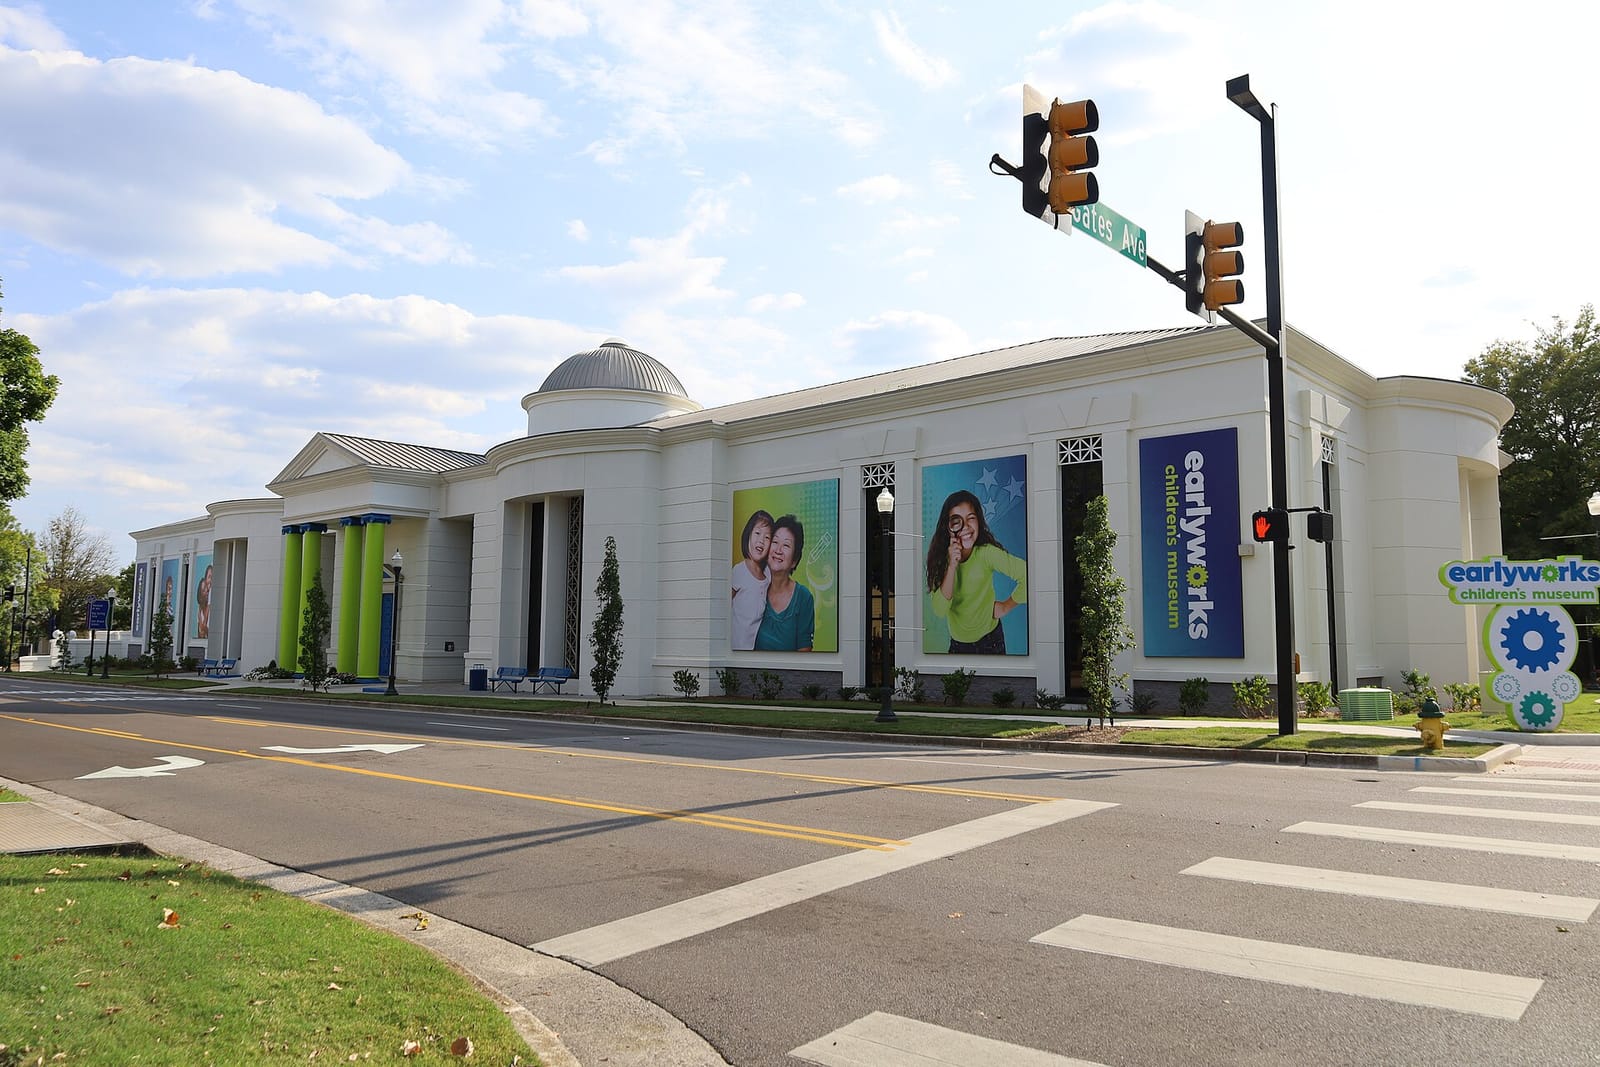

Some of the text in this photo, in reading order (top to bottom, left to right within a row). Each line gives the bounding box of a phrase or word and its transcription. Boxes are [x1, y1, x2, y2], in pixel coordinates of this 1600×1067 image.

[1073, 205, 1145, 260] Gates Ave
[1165, 464, 1181, 629] children's museum
[1179, 450, 1214, 640] earlyworks
[1449, 561, 1600, 587] earlyworks
[1461, 588, 1595, 600] children's museum
